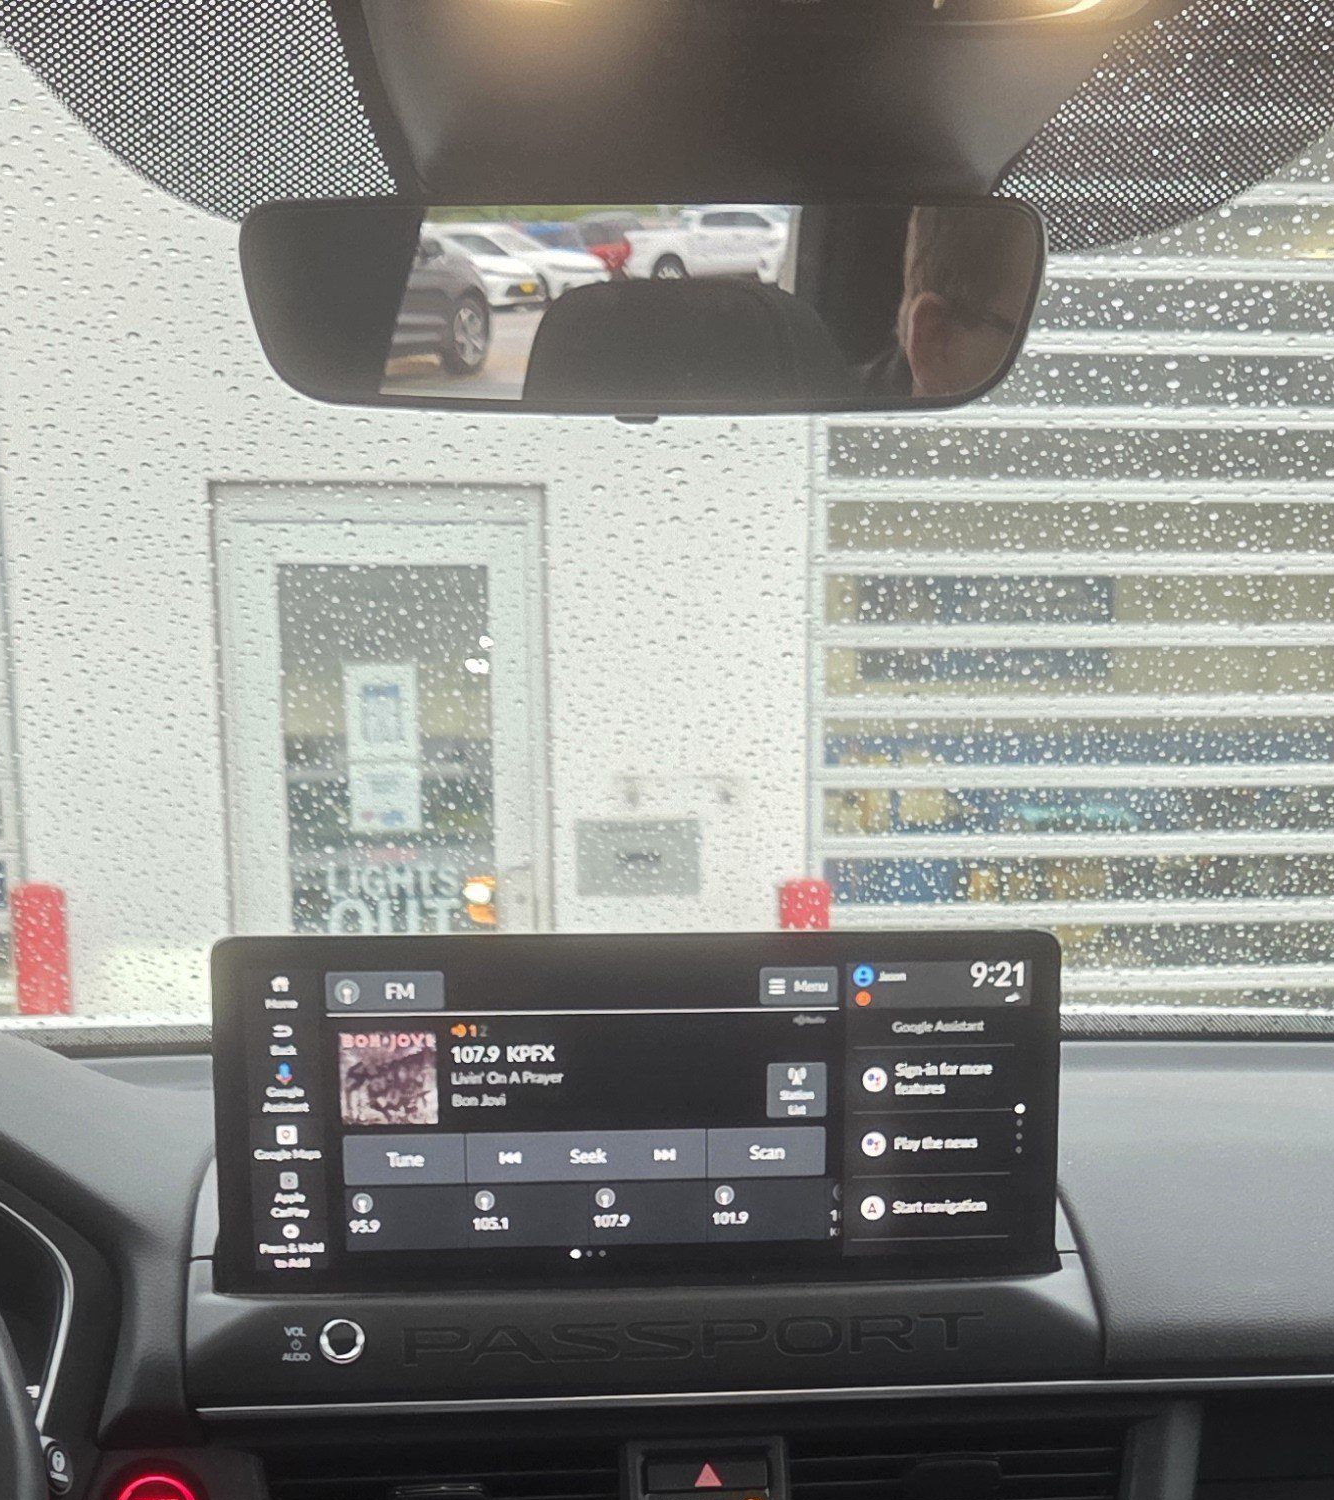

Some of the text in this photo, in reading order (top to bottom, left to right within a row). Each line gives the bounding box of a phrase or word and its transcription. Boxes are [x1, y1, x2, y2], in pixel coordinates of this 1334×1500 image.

[327, 866, 460, 898] LIGHTS
[969, 960, 1025, 988] 9:21
[384, 982, 415, 1000] FM
[793, 980, 828, 993] Menu
[891, 1020, 985, 1034] Google Assistant
[450, 1044, 555, 1064] 107.9 KPFX
[486, 1071, 507, 1085] On
[509, 1071, 521, 1084] A
[522, 1071, 565, 1086] Prayer
[451, 1093, 507, 1107] Bon Jovi
[385, 1151, 425, 1168] Tune
[569, 1148, 608, 1164] Seek
[748, 1144, 786, 1161] Scan
[593, 1214, 631, 1228] 107.9
[712, 1211, 750, 1225] 101.9
[283, 1326, 307, 1337] VOL
[402, 1310, 985, 1367] PASSPORT
[282, 1352, 311, 1361] AUDIO
